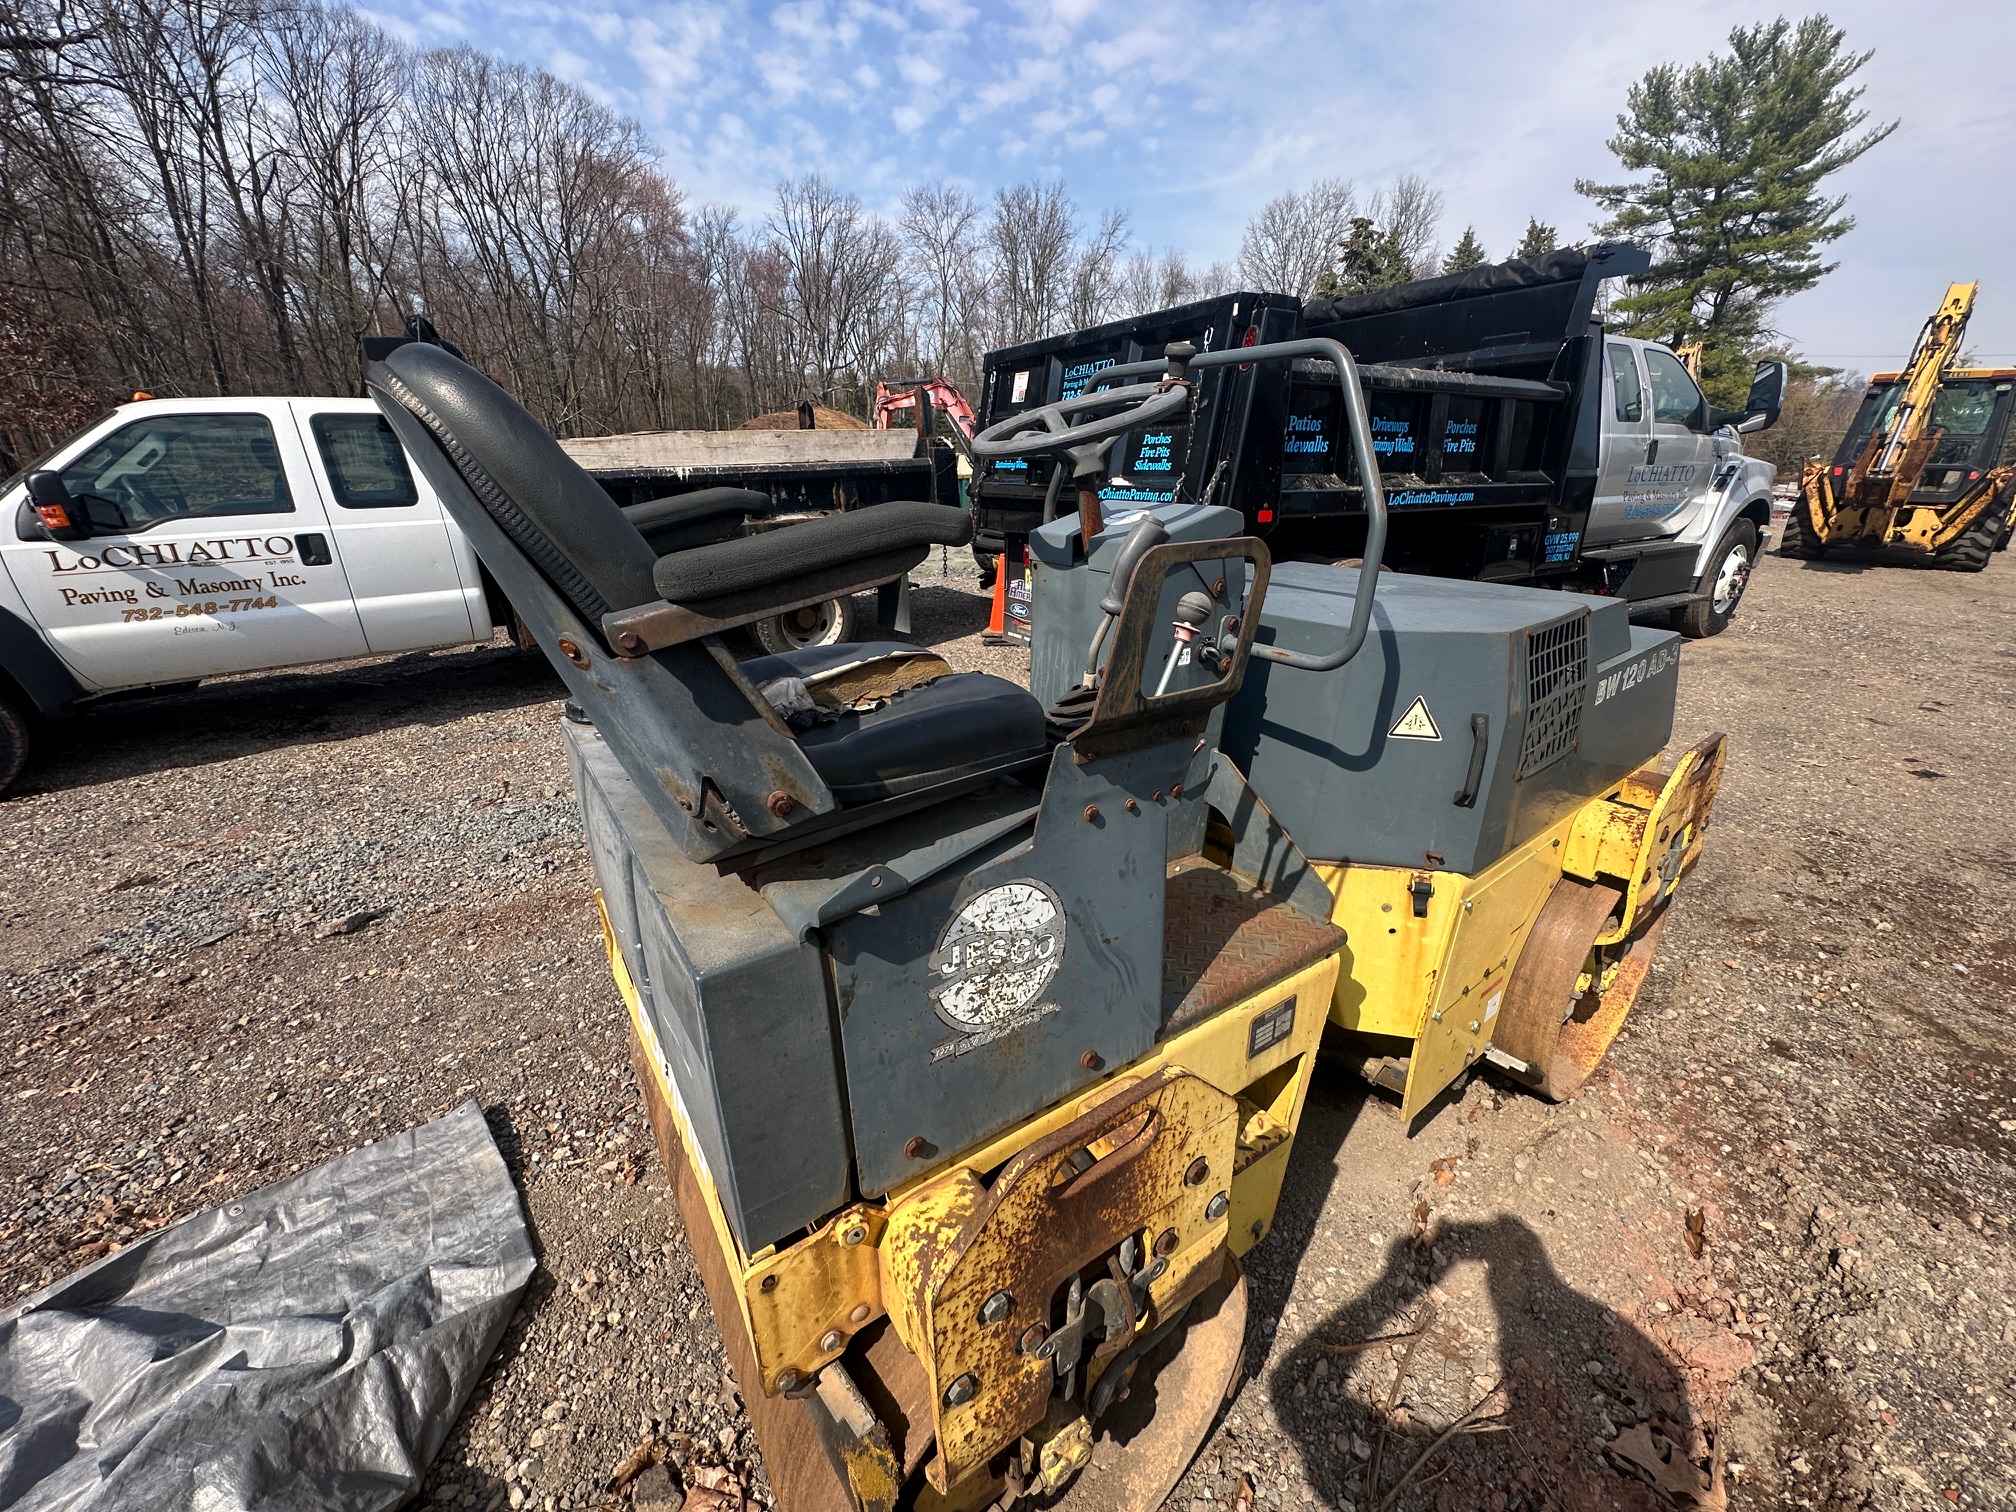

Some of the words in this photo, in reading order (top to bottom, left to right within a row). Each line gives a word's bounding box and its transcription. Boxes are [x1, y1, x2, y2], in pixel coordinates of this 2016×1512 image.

[1065, 358, 1116, 378] LoCHIATTO
[1288, 415, 1322, 432] Patios
[1371, 416, 1409, 437] Driveways
[1445, 418, 1478, 435] Porches
[1142, 432, 1173, 445] Porches
[1284, 435, 1329, 453] idewalks
[1394, 436, 1414, 453] Walls
[1442, 438, 1459, 453] Fire
[1459, 438, 1476, 453] Pits
[1139, 447, 1156, 458] Fire
[1154, 446, 1171, 458] Pits
[1134, 459, 1172, 471] Sidewalks
[1627, 465, 1695, 483] LoCHIATTO
[1388, 490, 1474, 506] LoChiattoPaving.com
[1623, 490, 1645, 504] Paving
[1544, 534, 1560, 545] GVW
[43, 535, 295, 572] LoCHIATTO
[58, 587, 138, 607] Paving
[145, 581, 170, 599] &
[173, 578, 263, 597] Masonry
[267, 571, 306, 588] Inc.
[121, 595, 278, 623] 732-548-7744
[1011, 604, 1028, 616] Ford
[1594, 670, 1622, 706] BW
[1622, 658, 1647, 692] 120
[1646, 642, 1680, 679] AD-3
[941, 933, 1056, 975] JESCO
